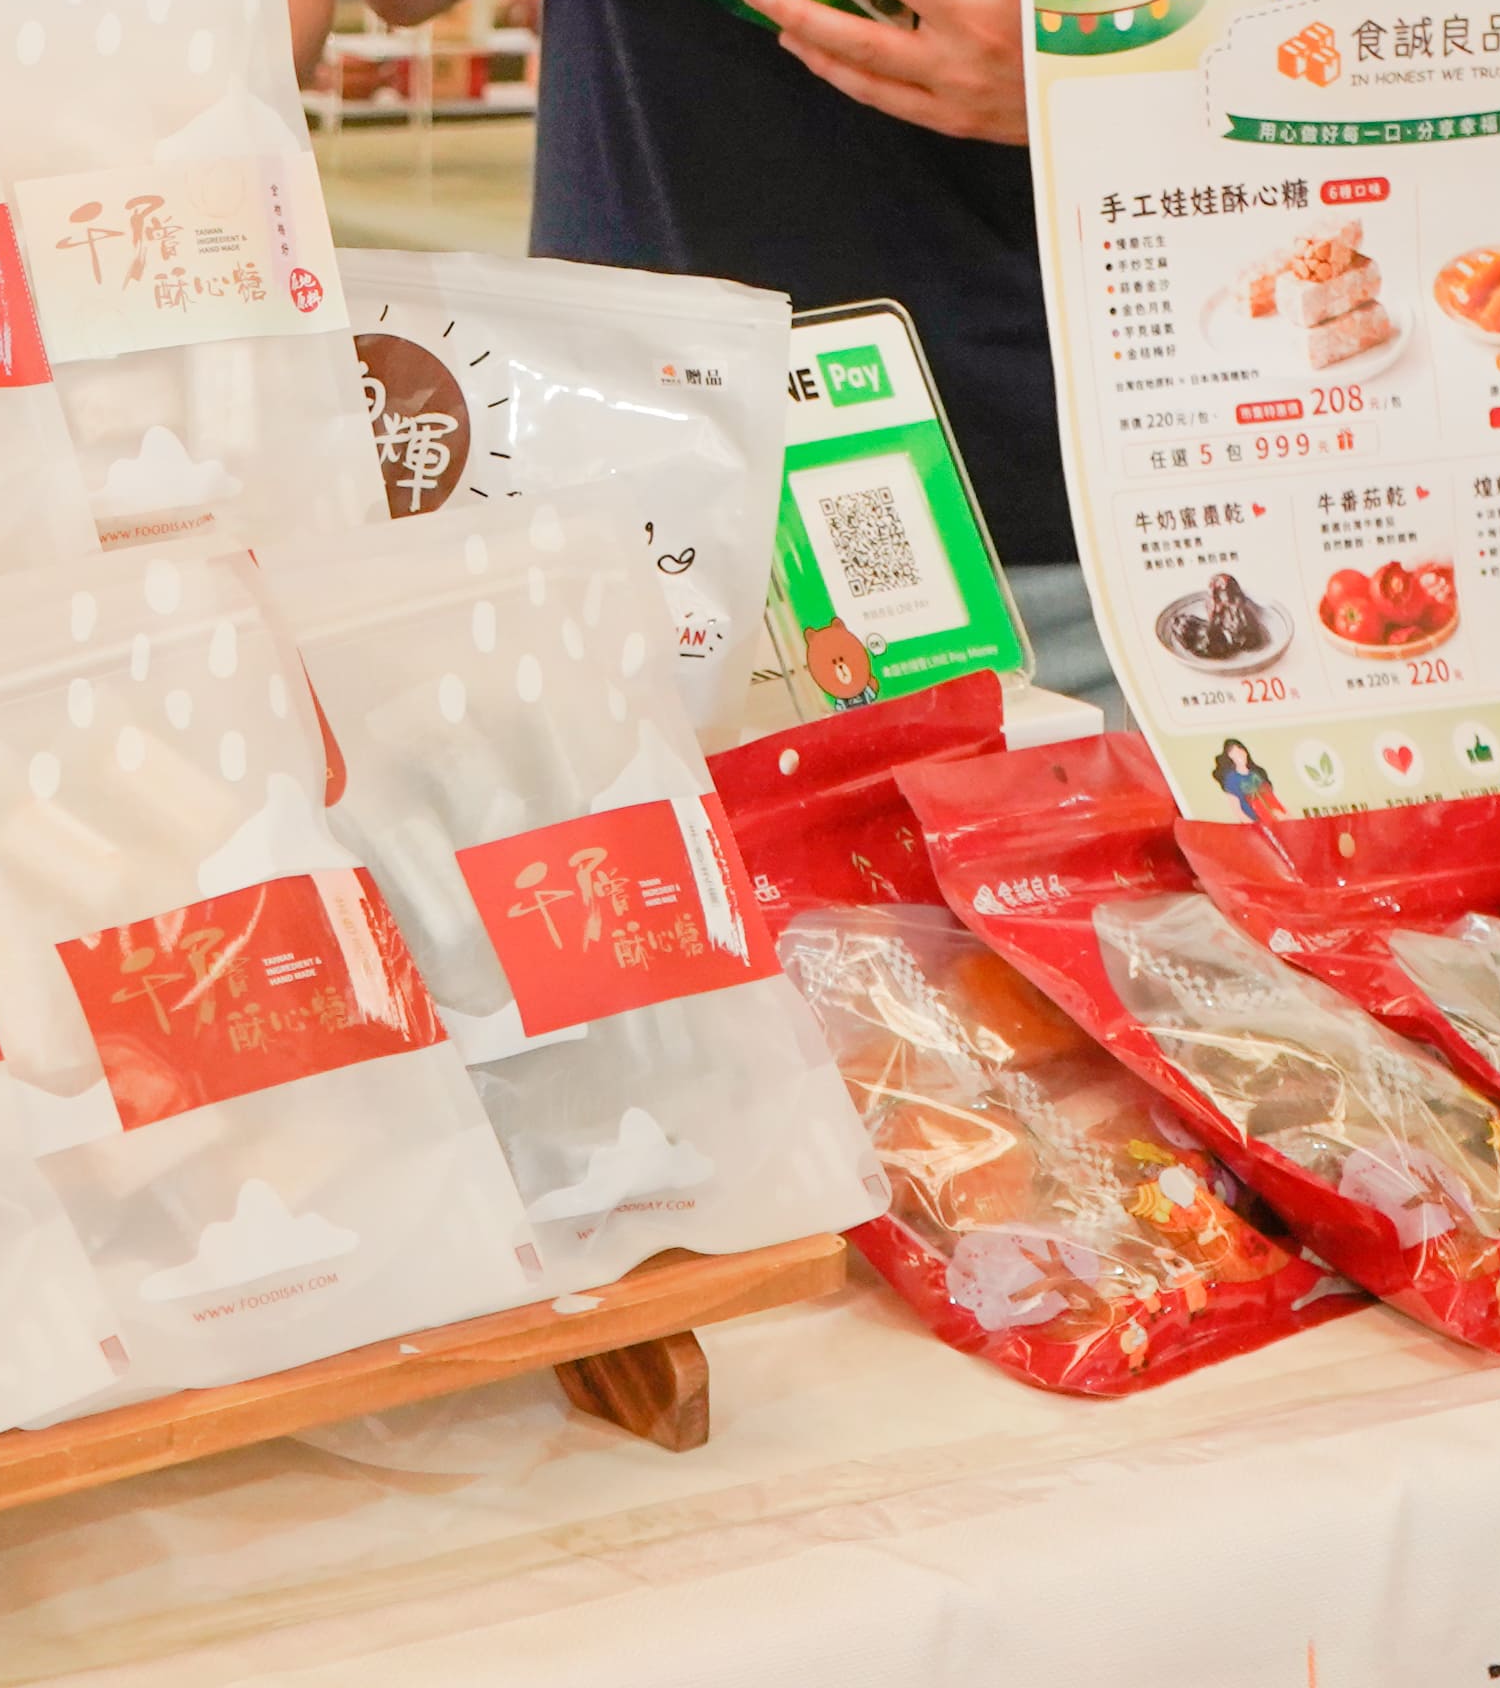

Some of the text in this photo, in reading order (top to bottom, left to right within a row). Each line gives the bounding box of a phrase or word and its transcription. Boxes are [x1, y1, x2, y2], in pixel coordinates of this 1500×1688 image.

[1350, 73, 1369, 87] IN
[1375, 70, 1434, 85] HONEST
[1442, 68, 1464, 82] WE
[1100, 178, 1309, 223] 手工娃娃酥心糖
[788, 363, 880, 403] NE Pay
[1310, 384, 1365, 416] 208
[356, 360, 459, 512] 輝
[1200, 443, 1214, 465] 5
[1255, 432, 1311, 461] 999
[1407, 658, 1450, 687] 220
[1241, 676, 1287, 704] 220
[192, 1271, 339, 1324] WWW.FOODISAY.COM
